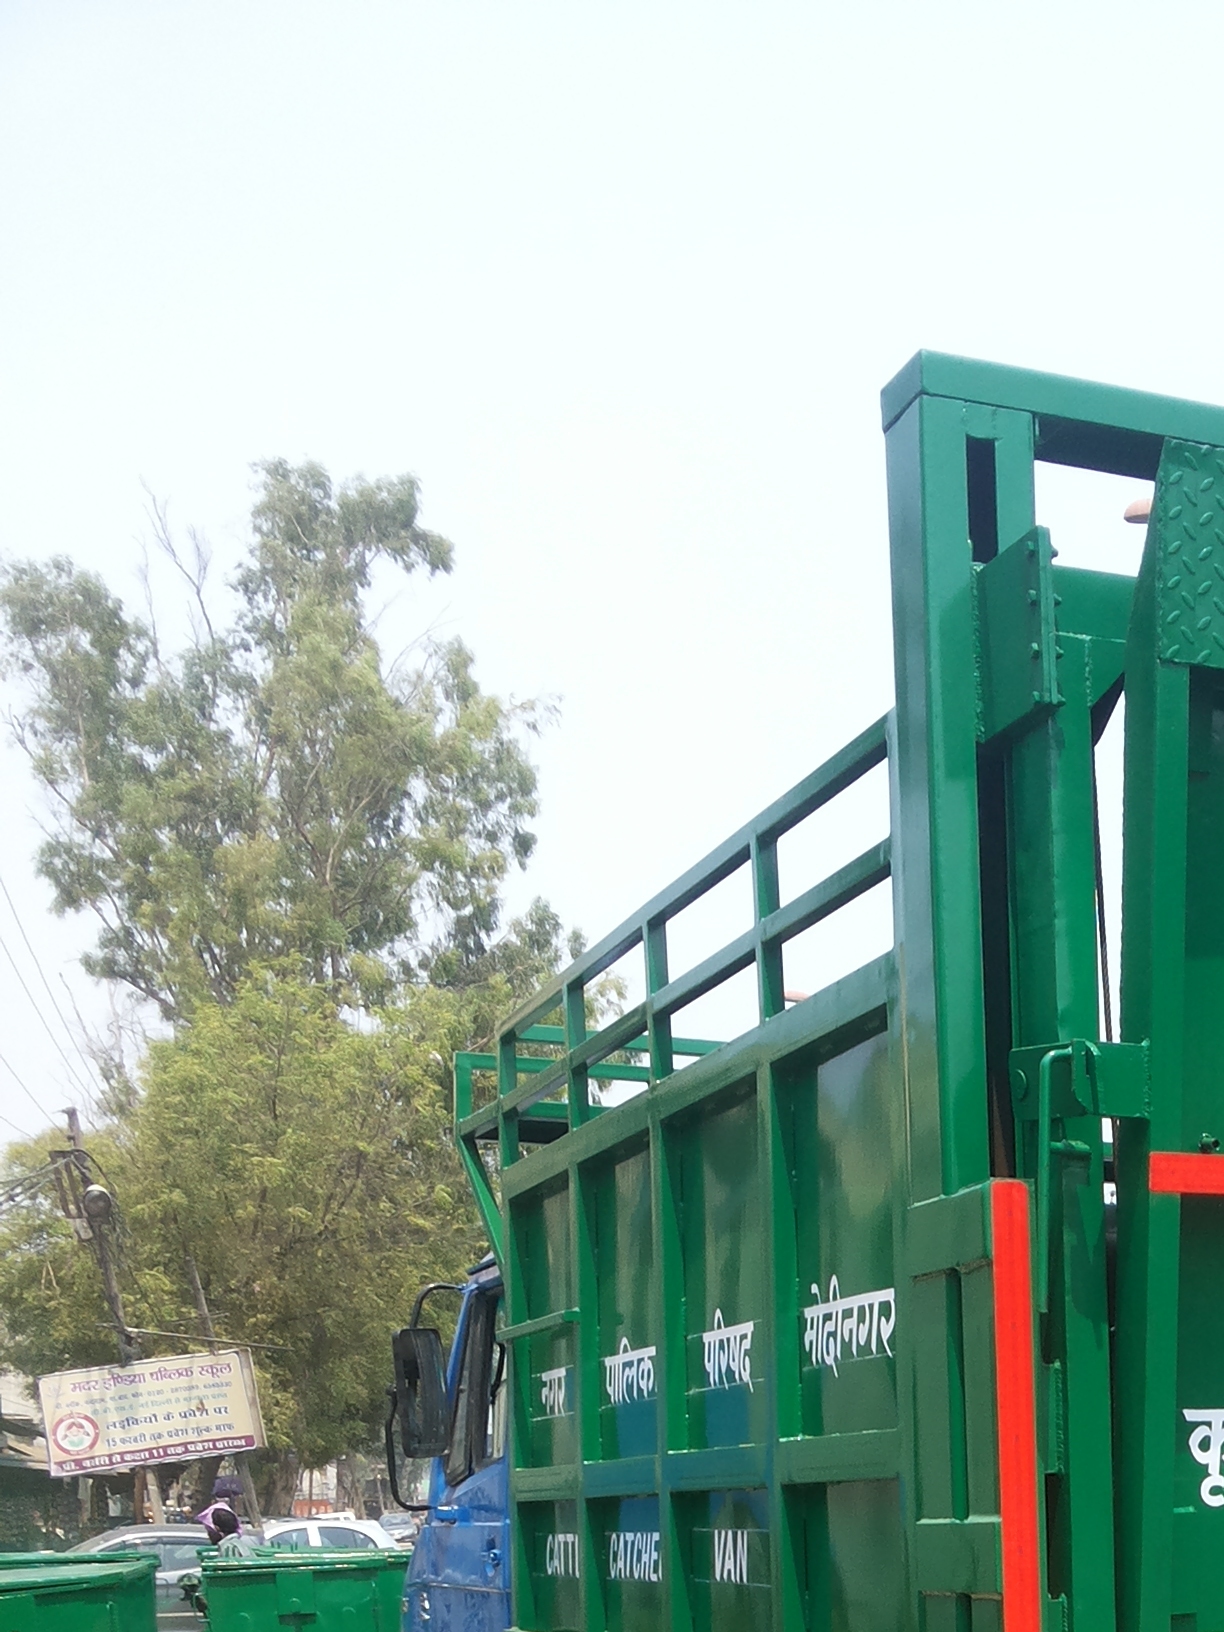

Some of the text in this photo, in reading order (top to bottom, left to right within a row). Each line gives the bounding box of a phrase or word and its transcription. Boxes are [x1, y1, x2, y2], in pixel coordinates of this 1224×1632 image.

[541, 1274, 895, 1417] नगर पालिक परिषद मोदीनगर
[70, 1380, 99, 1393] मदर
[198, 1362, 232, 1379] स्कूल
[106, 1438, 117, 1448] 15
[545, 1529, 748, 1584] CATTL CATCHE VAN
